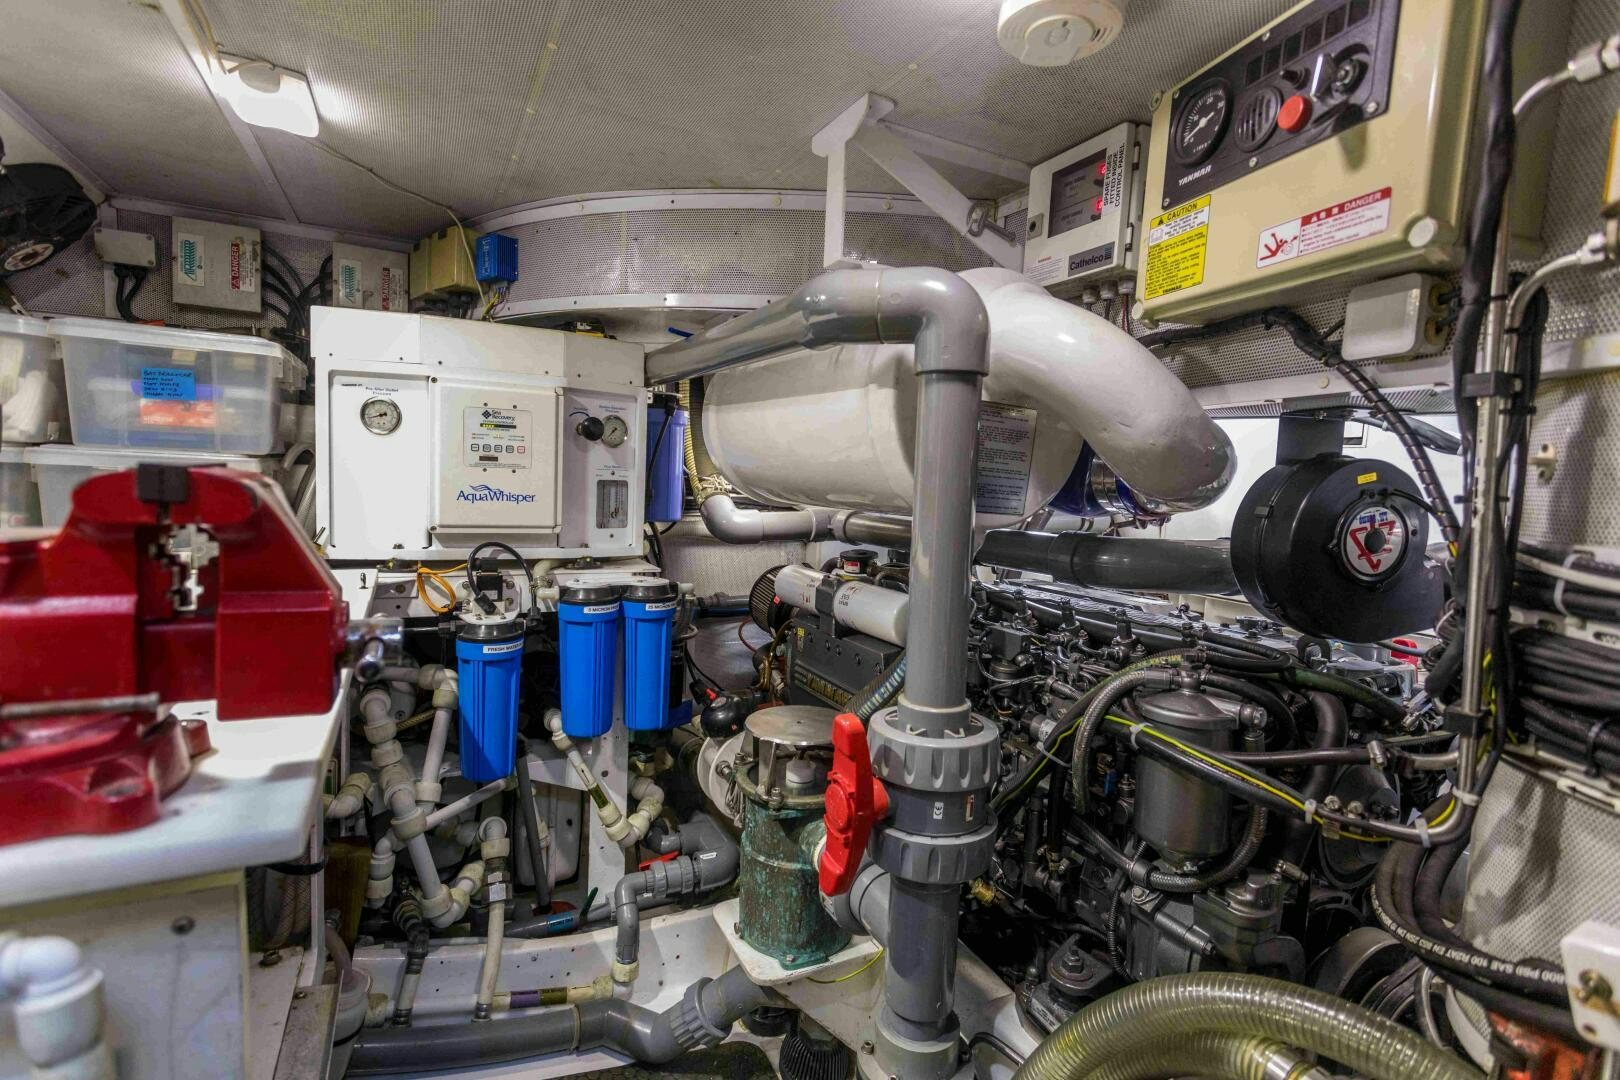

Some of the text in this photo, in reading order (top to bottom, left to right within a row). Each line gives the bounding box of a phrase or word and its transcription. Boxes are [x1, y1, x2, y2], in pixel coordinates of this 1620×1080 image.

[1114, 143, 1125, 207] CONTROL PANEL
[1178, 165, 1212, 186] YANMAR
[1343, 191, 1382, 211] DANGER
[1166, 203, 1198, 221] CAUTION
[231, 246, 239, 277] DANGER
[1069, 253, 1104, 271] Cathelco
[491, 414, 515, 422] Recovery
[457, 489, 536, 505] AquaWhisper
